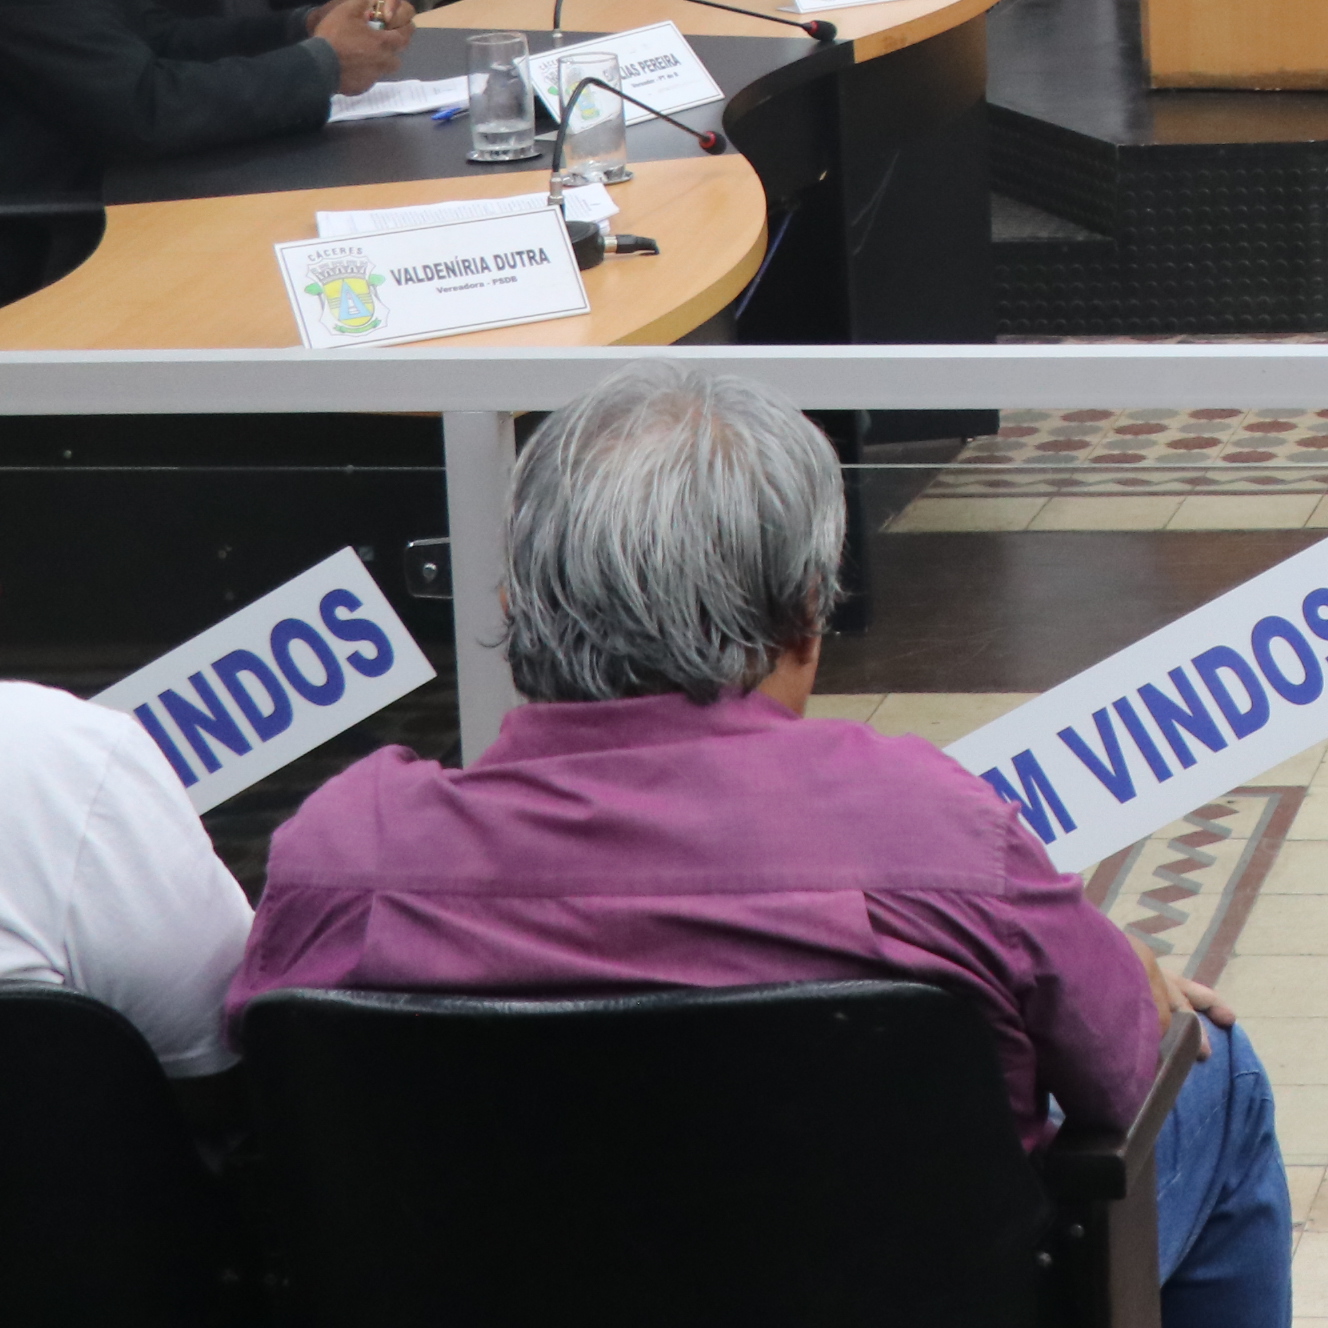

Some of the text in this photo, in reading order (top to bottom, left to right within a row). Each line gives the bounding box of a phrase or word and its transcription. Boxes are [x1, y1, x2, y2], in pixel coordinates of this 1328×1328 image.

[640, 52, 682, 76] PEREIRA
[307, 246, 364, 262] CÁCERES
[390, 247, 551, 286] VALDENÍRIA DUTRA
[436, 281, 485, 295] Vereadora
[492, 275, 518, 287] PSDB
